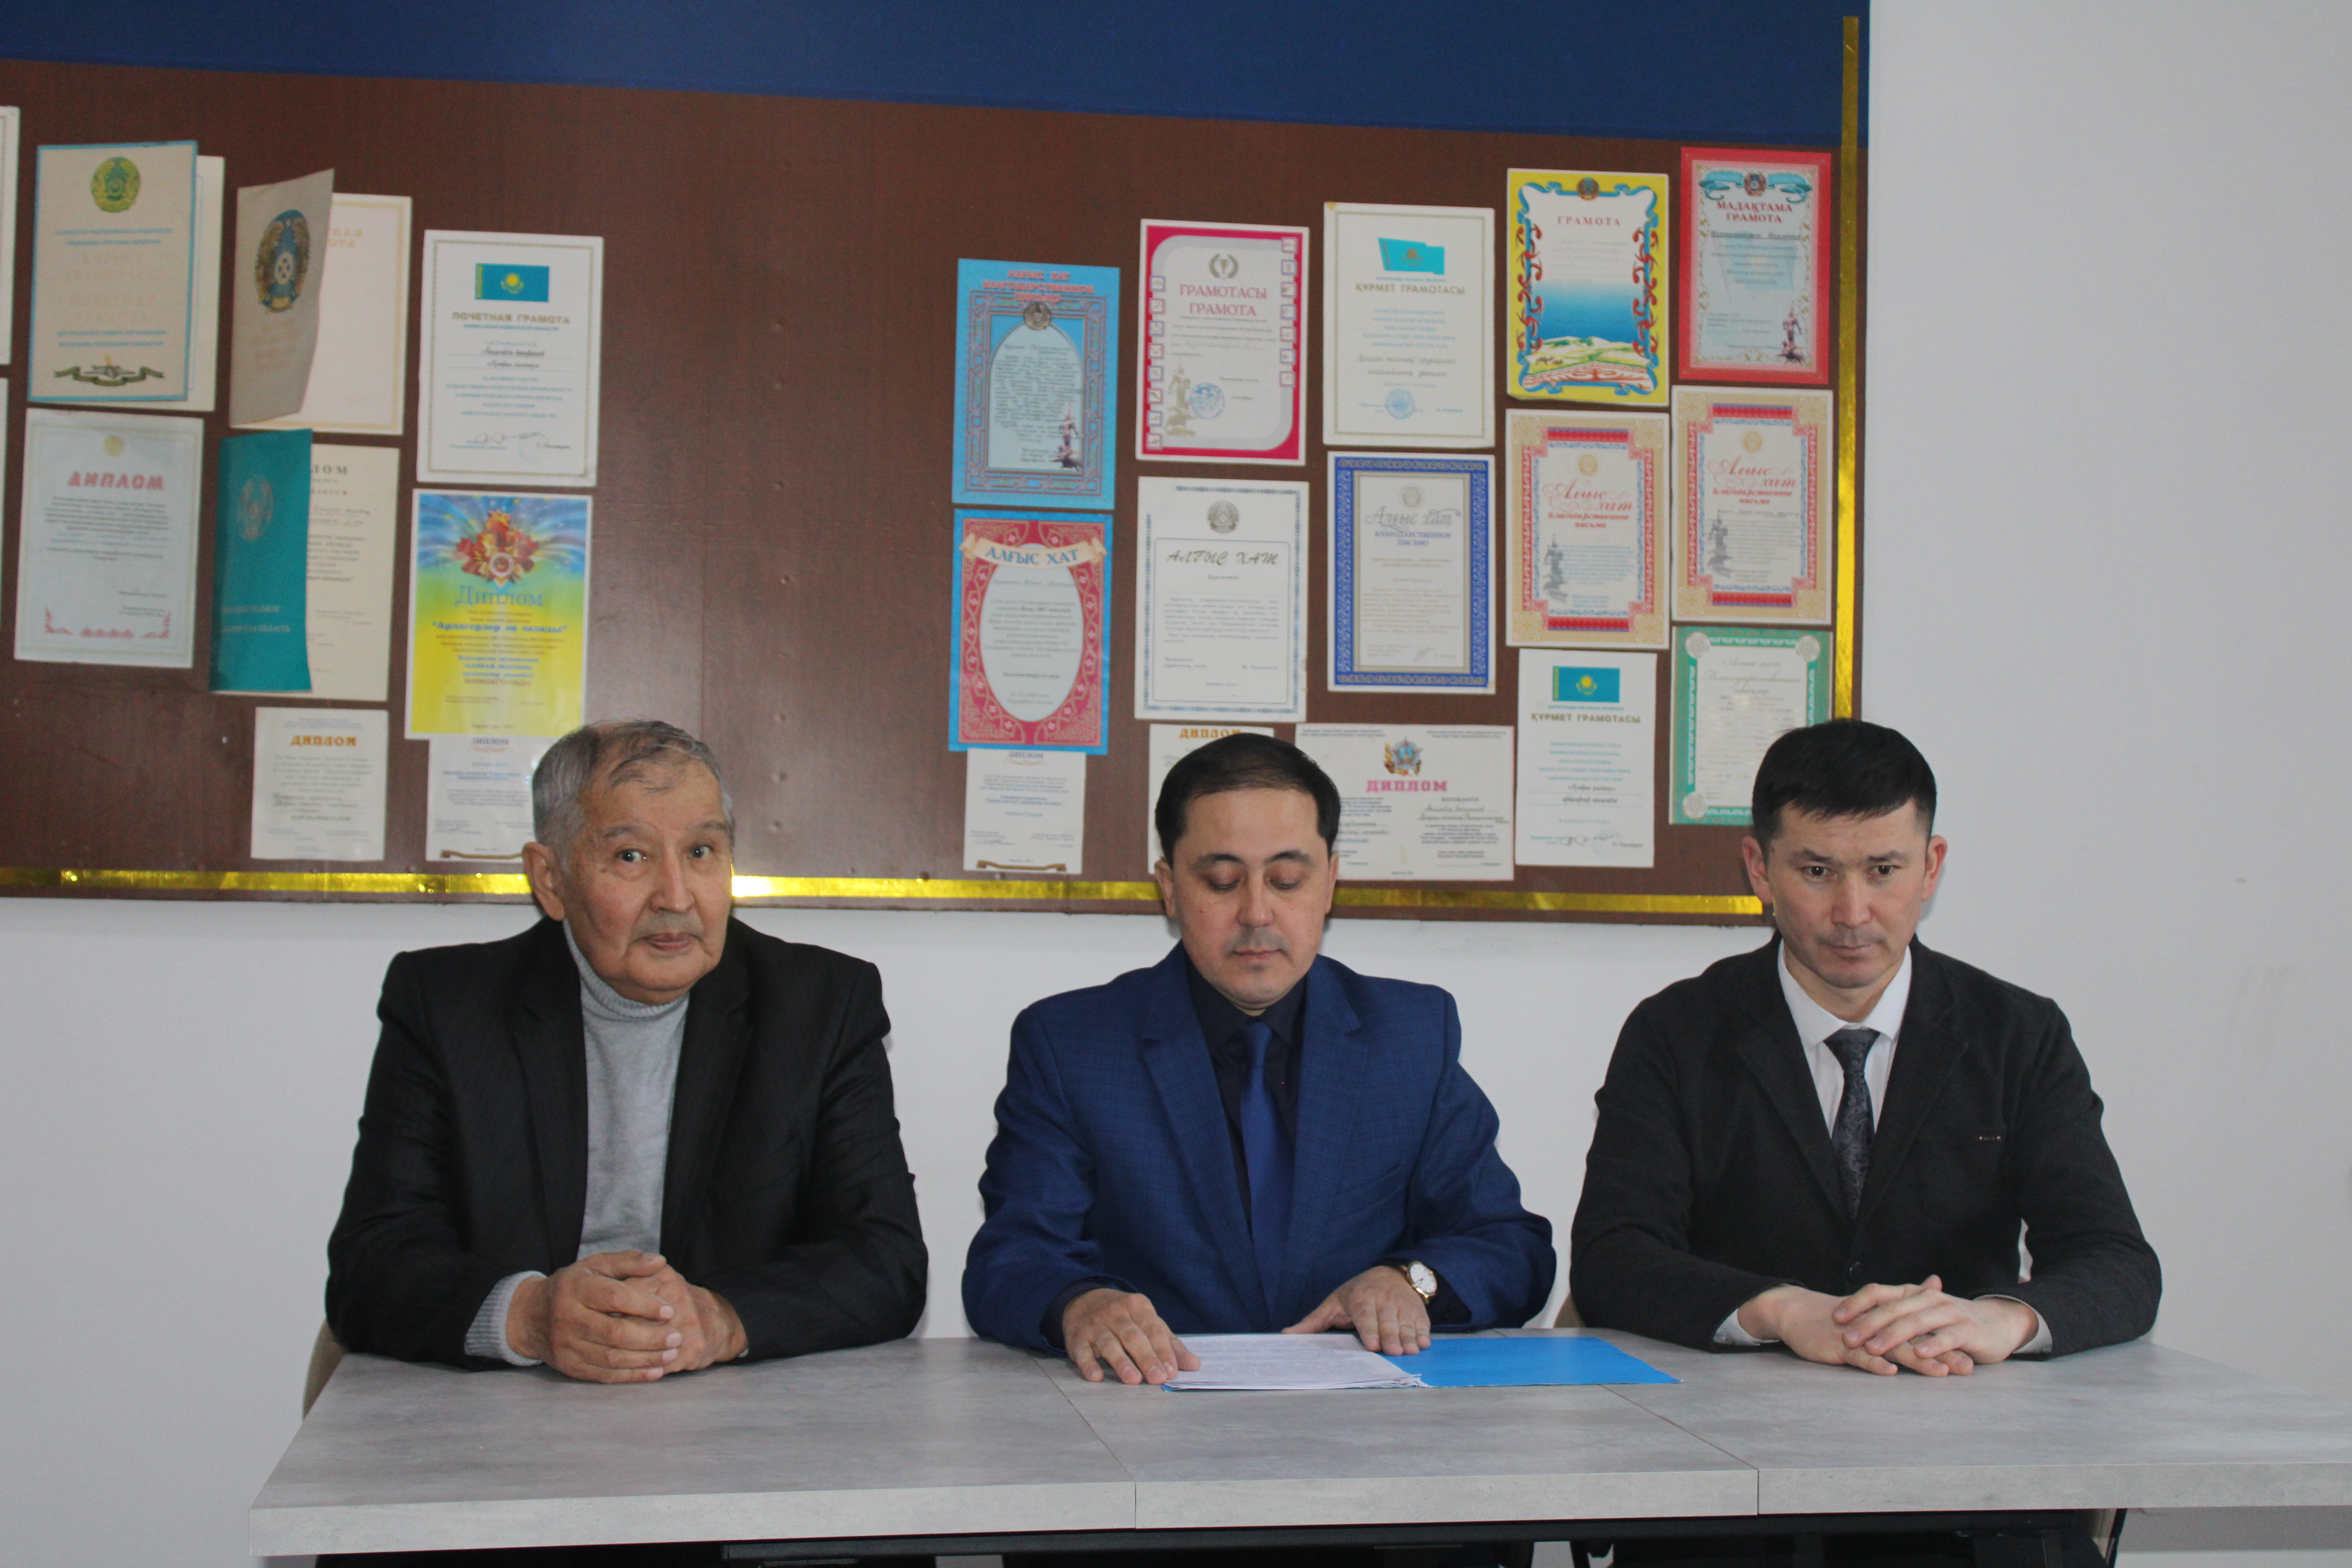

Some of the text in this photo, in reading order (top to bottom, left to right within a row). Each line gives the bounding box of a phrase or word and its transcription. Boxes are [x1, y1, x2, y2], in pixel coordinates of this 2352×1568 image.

[1557, 216, 1621, 226] ГРАМОТА
[1726, 213, 1782, 223] ГРАМОТА
[1050, 271, 1070, 281] ХАТ
[982, 279, 1094, 293] БЛАГОДАРСТВЕННОЕ
[1180, 284, 1267, 299] ГРАМОТАСЫ
[1401, 285, 1465, 294] ГРАМОТАСЫ
[1189, 302, 1256, 316] ГРАМОТА
[452, 312, 571, 323] ПОЧЕТНАЯ ГРАМОТА
[311, 464, 347, 474] ЛОМ
[68, 472, 163, 490] ДИПЛОМ
[985, 547, 1078, 564] АЛҒЫС ХАТ
[1236, 552, 1278, 564] ХАТ
[455, 585, 543, 606] Диплом
[1577, 714, 1641, 723] ГРАМОТАСЫ
[290, 735, 357, 746] ДИПЛОМ
[1366, 780, 1448, 793] ДИПЛОМ
